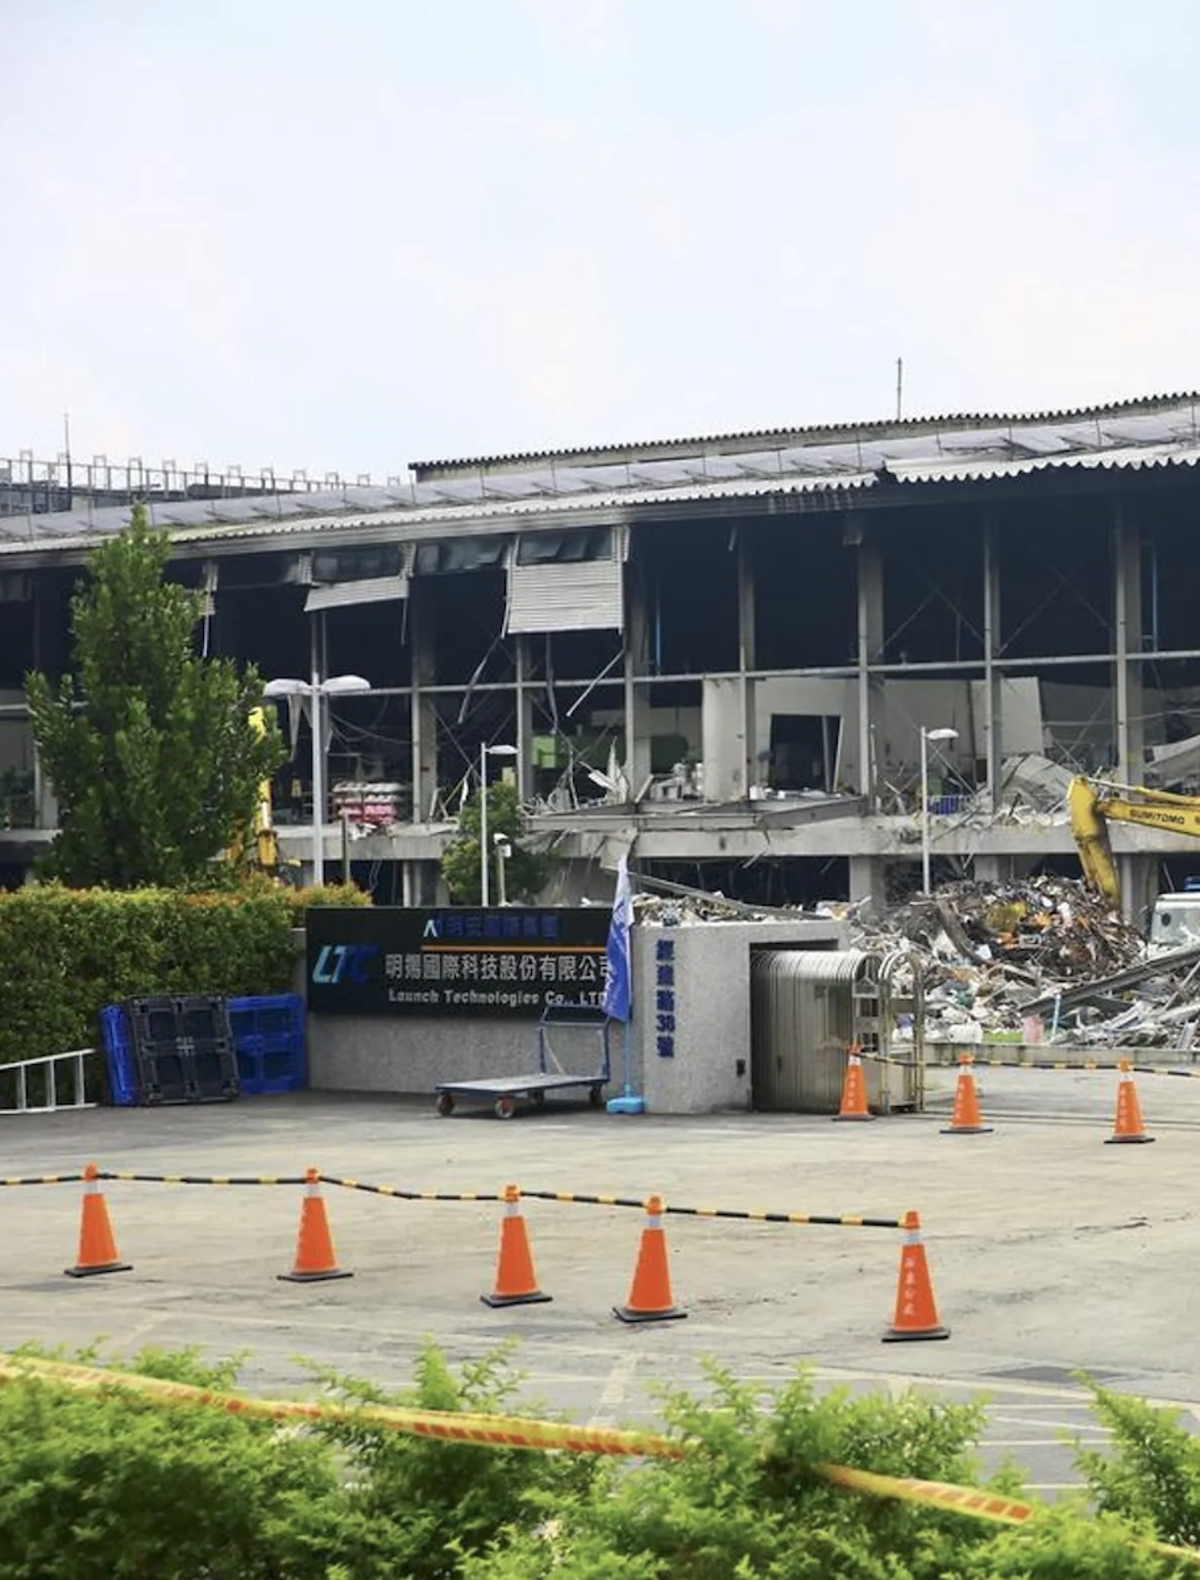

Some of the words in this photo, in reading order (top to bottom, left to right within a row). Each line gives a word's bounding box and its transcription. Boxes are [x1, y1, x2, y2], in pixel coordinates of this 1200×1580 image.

[1129, 809, 1186, 825] SUMITOMO
[312, 944, 379, 985] LTC
[388, 989, 439, 1003] Launch
[444, 990, 539, 1008] Technologies
